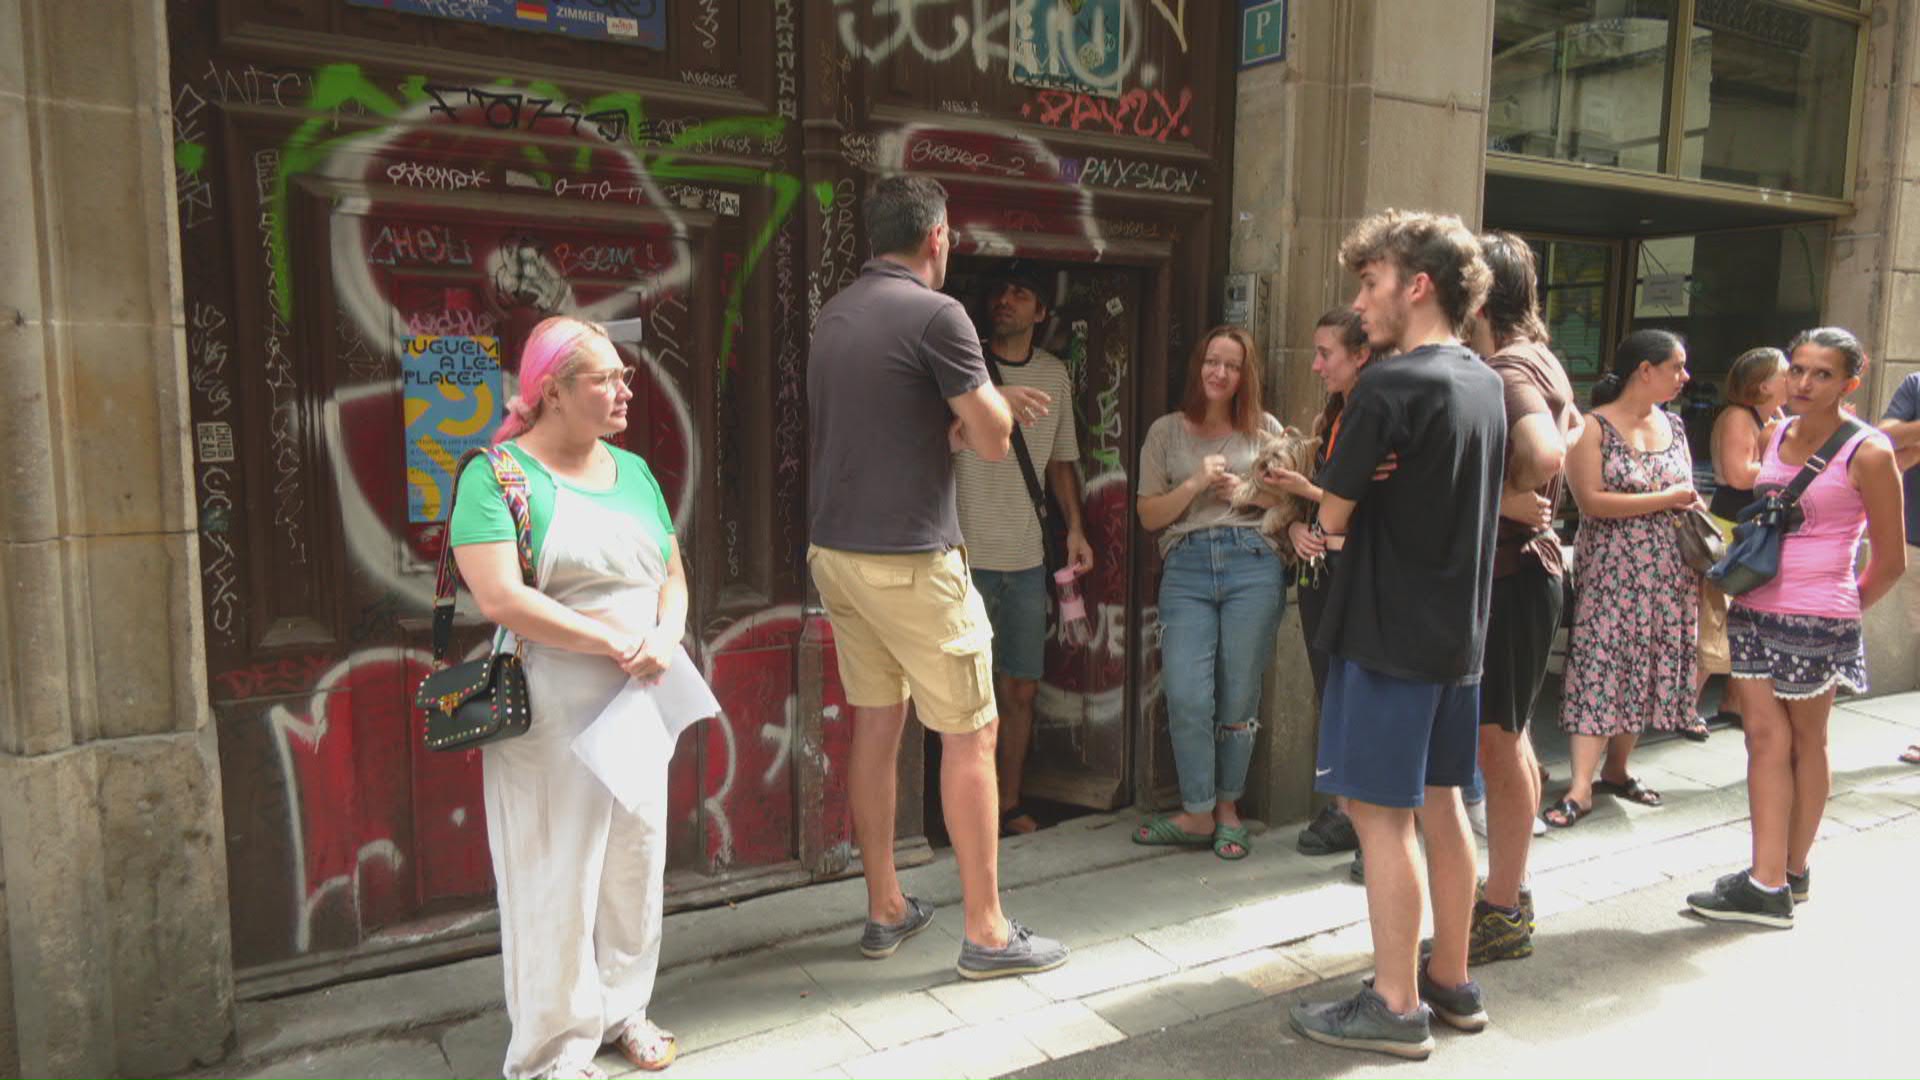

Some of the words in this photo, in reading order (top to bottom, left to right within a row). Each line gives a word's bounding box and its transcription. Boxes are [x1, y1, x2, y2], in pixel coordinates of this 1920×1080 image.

[556, 5, 606, 24] ZIMMER
[1256, 10, 1271, 41] P
[402, 339, 499, 355] JUGUEM
[440, 355, 455, 370] A
[462, 356, 500, 371] LES
[404, 370, 484, 386] PLACES
